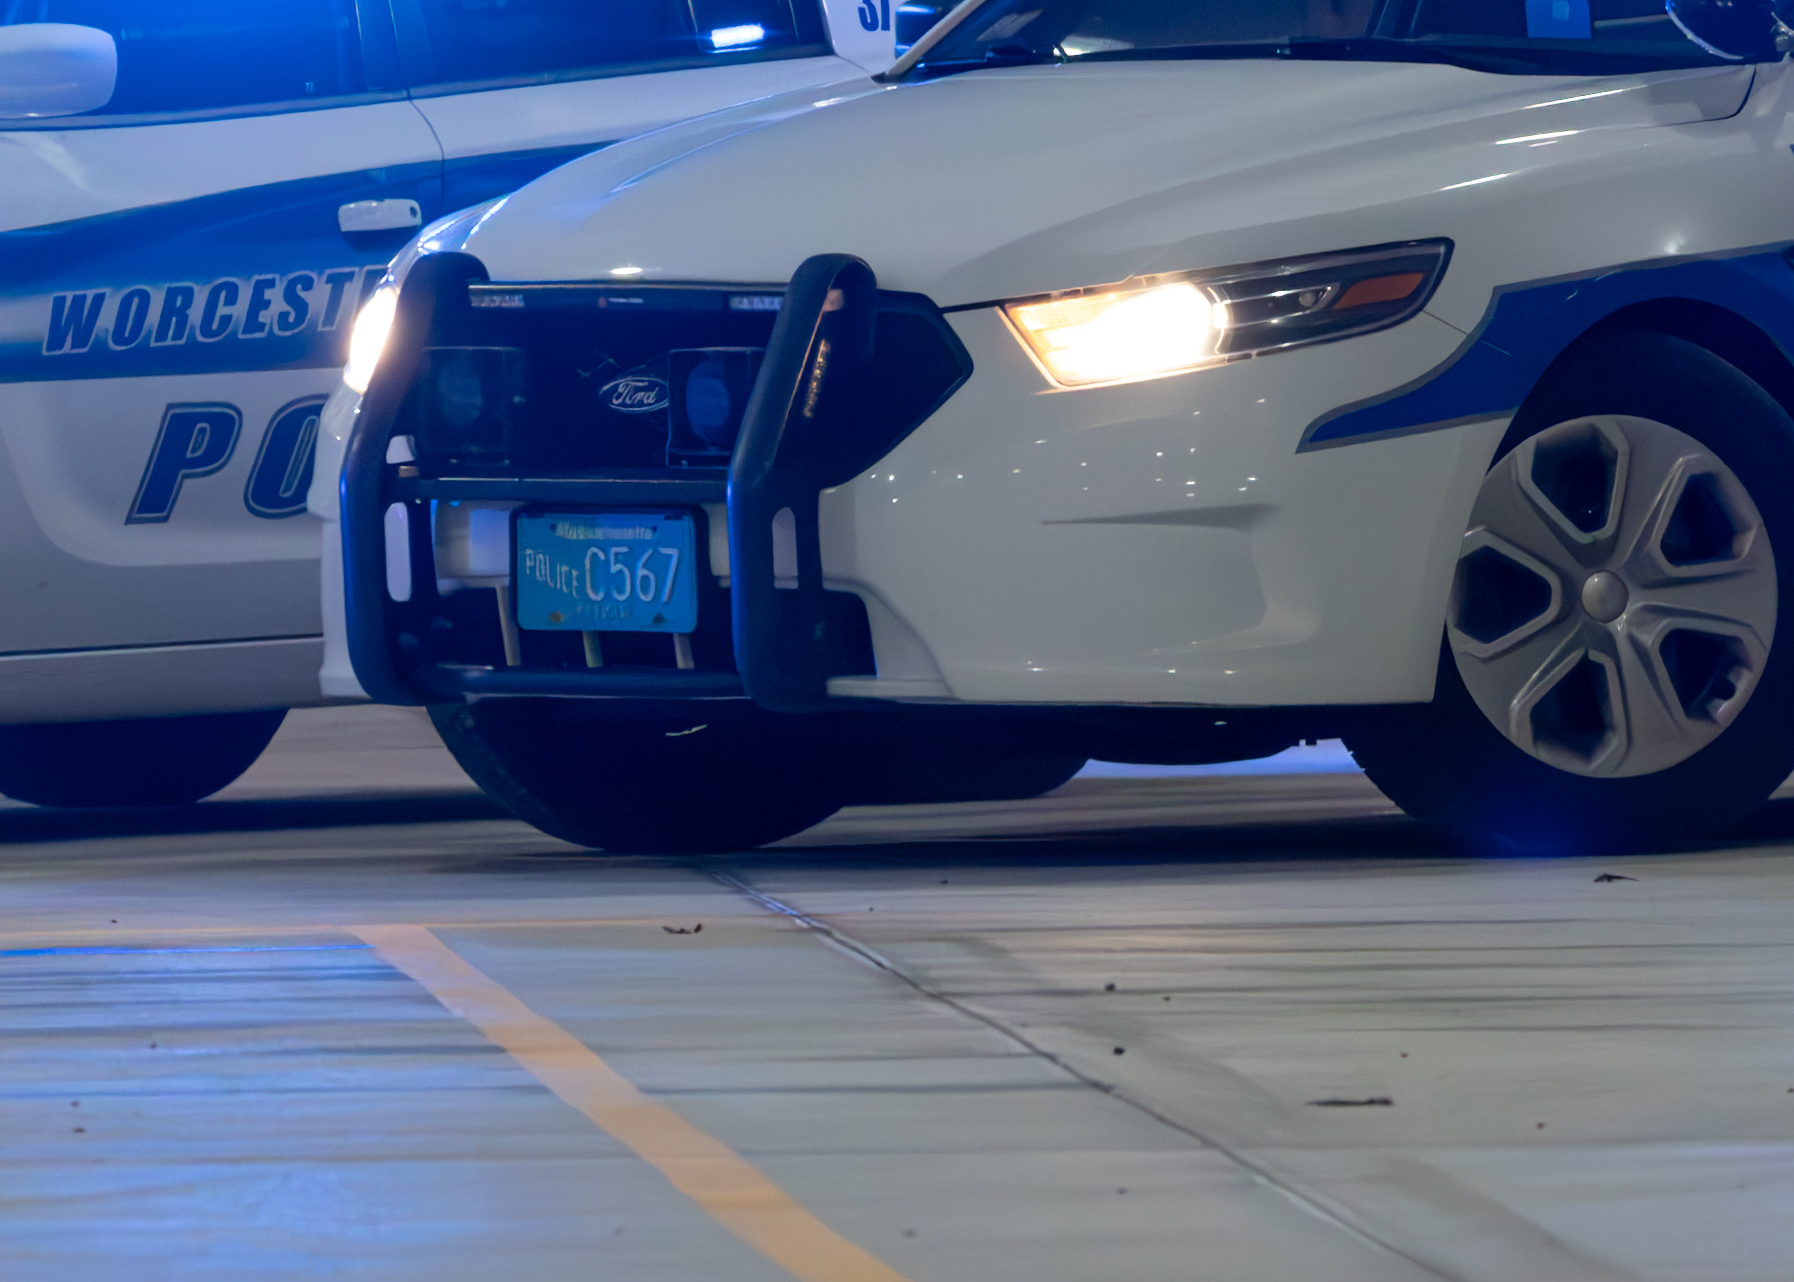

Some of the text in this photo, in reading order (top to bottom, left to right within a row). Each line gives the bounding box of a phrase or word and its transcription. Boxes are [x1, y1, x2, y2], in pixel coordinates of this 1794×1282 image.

[611, 379, 660, 405] Ford
[524, 546, 679, 603] POLICE C567
